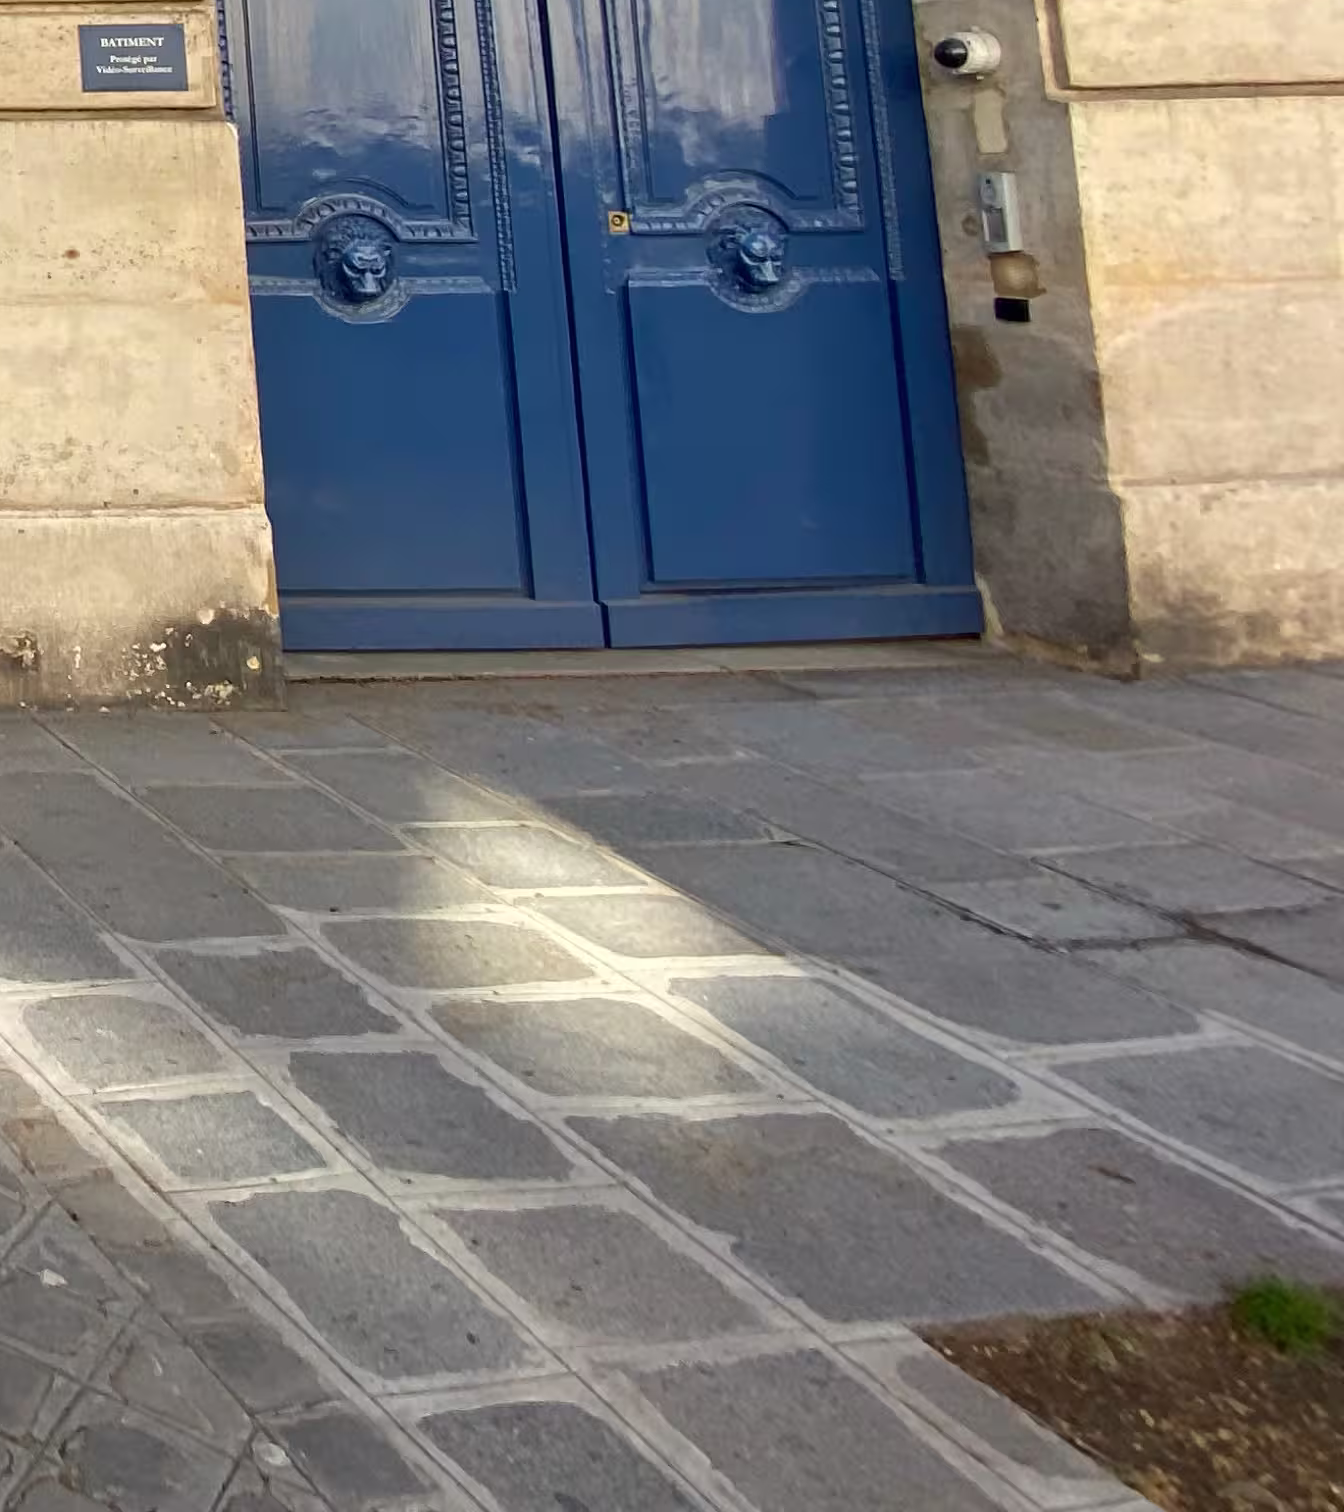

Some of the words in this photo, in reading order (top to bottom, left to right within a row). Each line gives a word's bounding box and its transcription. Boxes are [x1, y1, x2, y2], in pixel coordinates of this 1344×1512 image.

[100, 37, 164, 48] BATIMENT
[110, 55, 142, 64] Protégé
[143, 56, 157, 64] par
